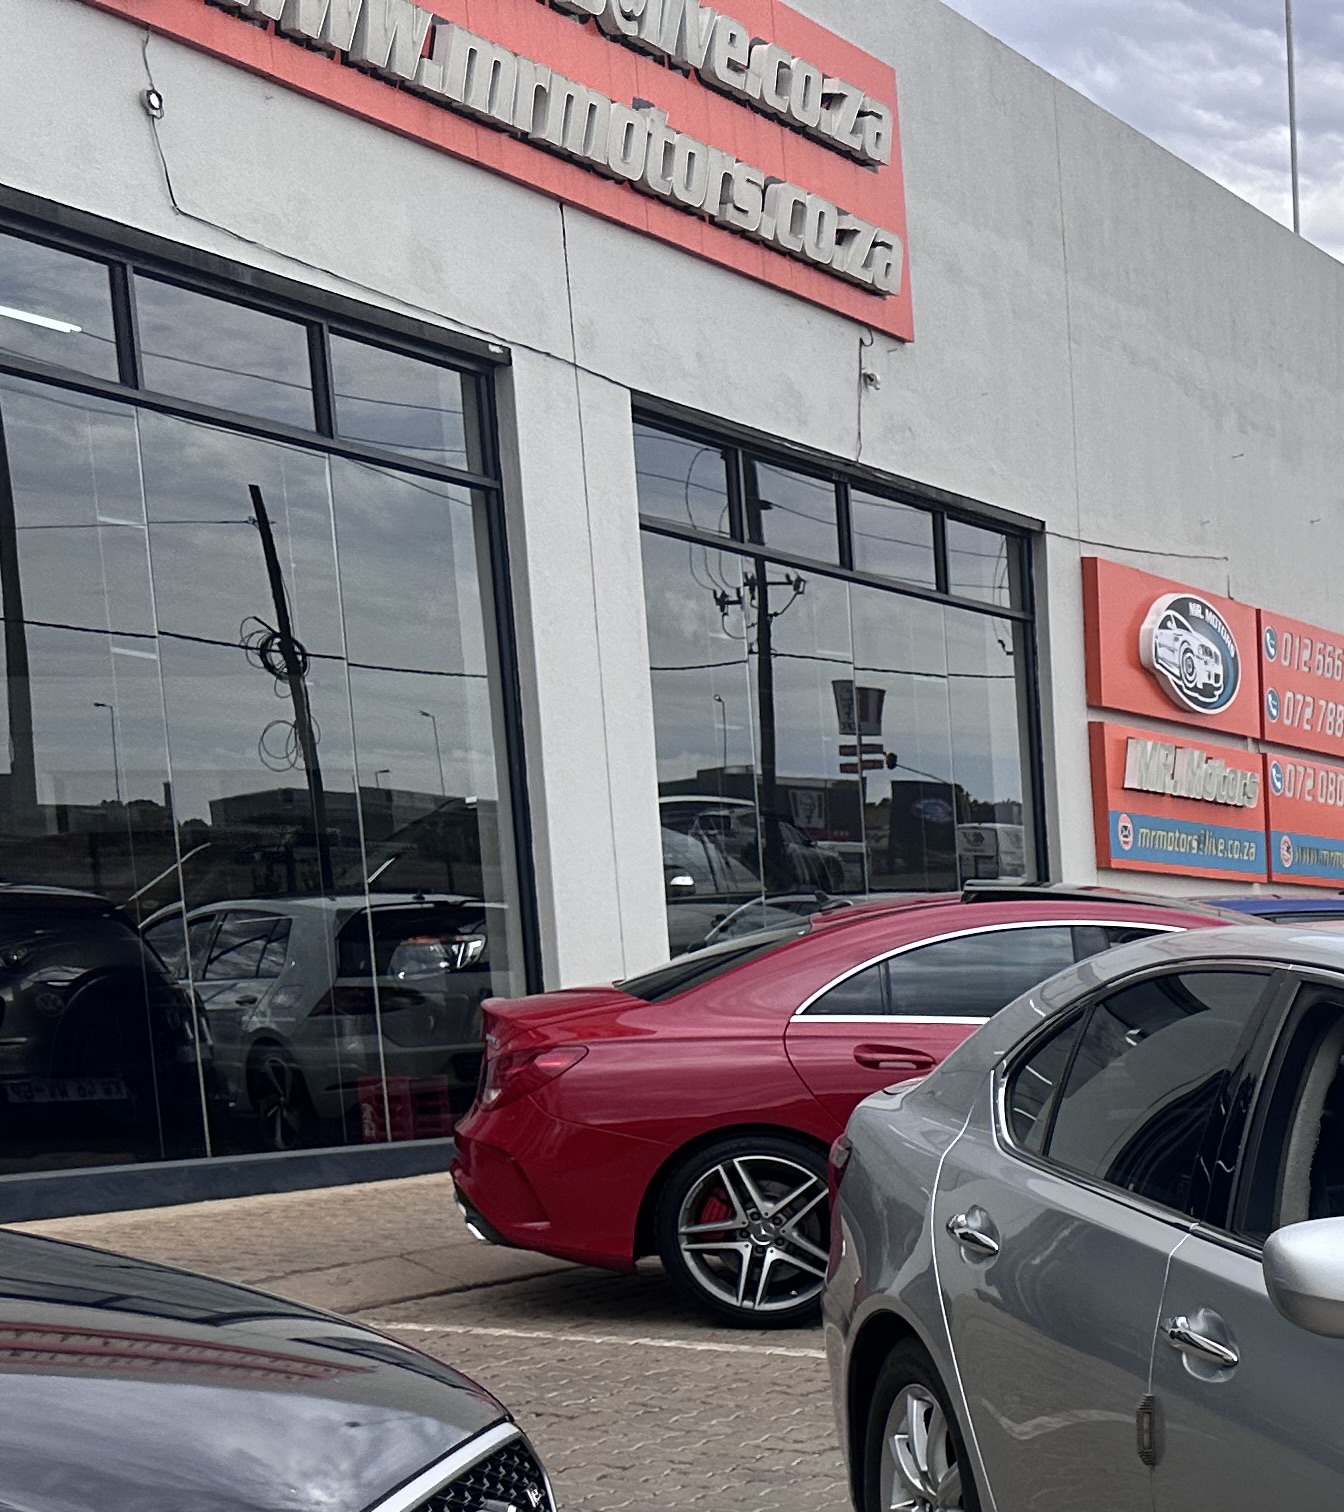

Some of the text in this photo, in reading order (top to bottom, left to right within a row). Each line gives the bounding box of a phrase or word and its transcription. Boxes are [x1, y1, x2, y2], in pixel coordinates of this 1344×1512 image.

[1281, 632, 1313, 673] 012
[1315, 641, 1344, 681] 666
[1283, 691, 1315, 731] 072
[1174, 748, 1259, 808] Motors
[1285, 763, 1315, 801] 072
